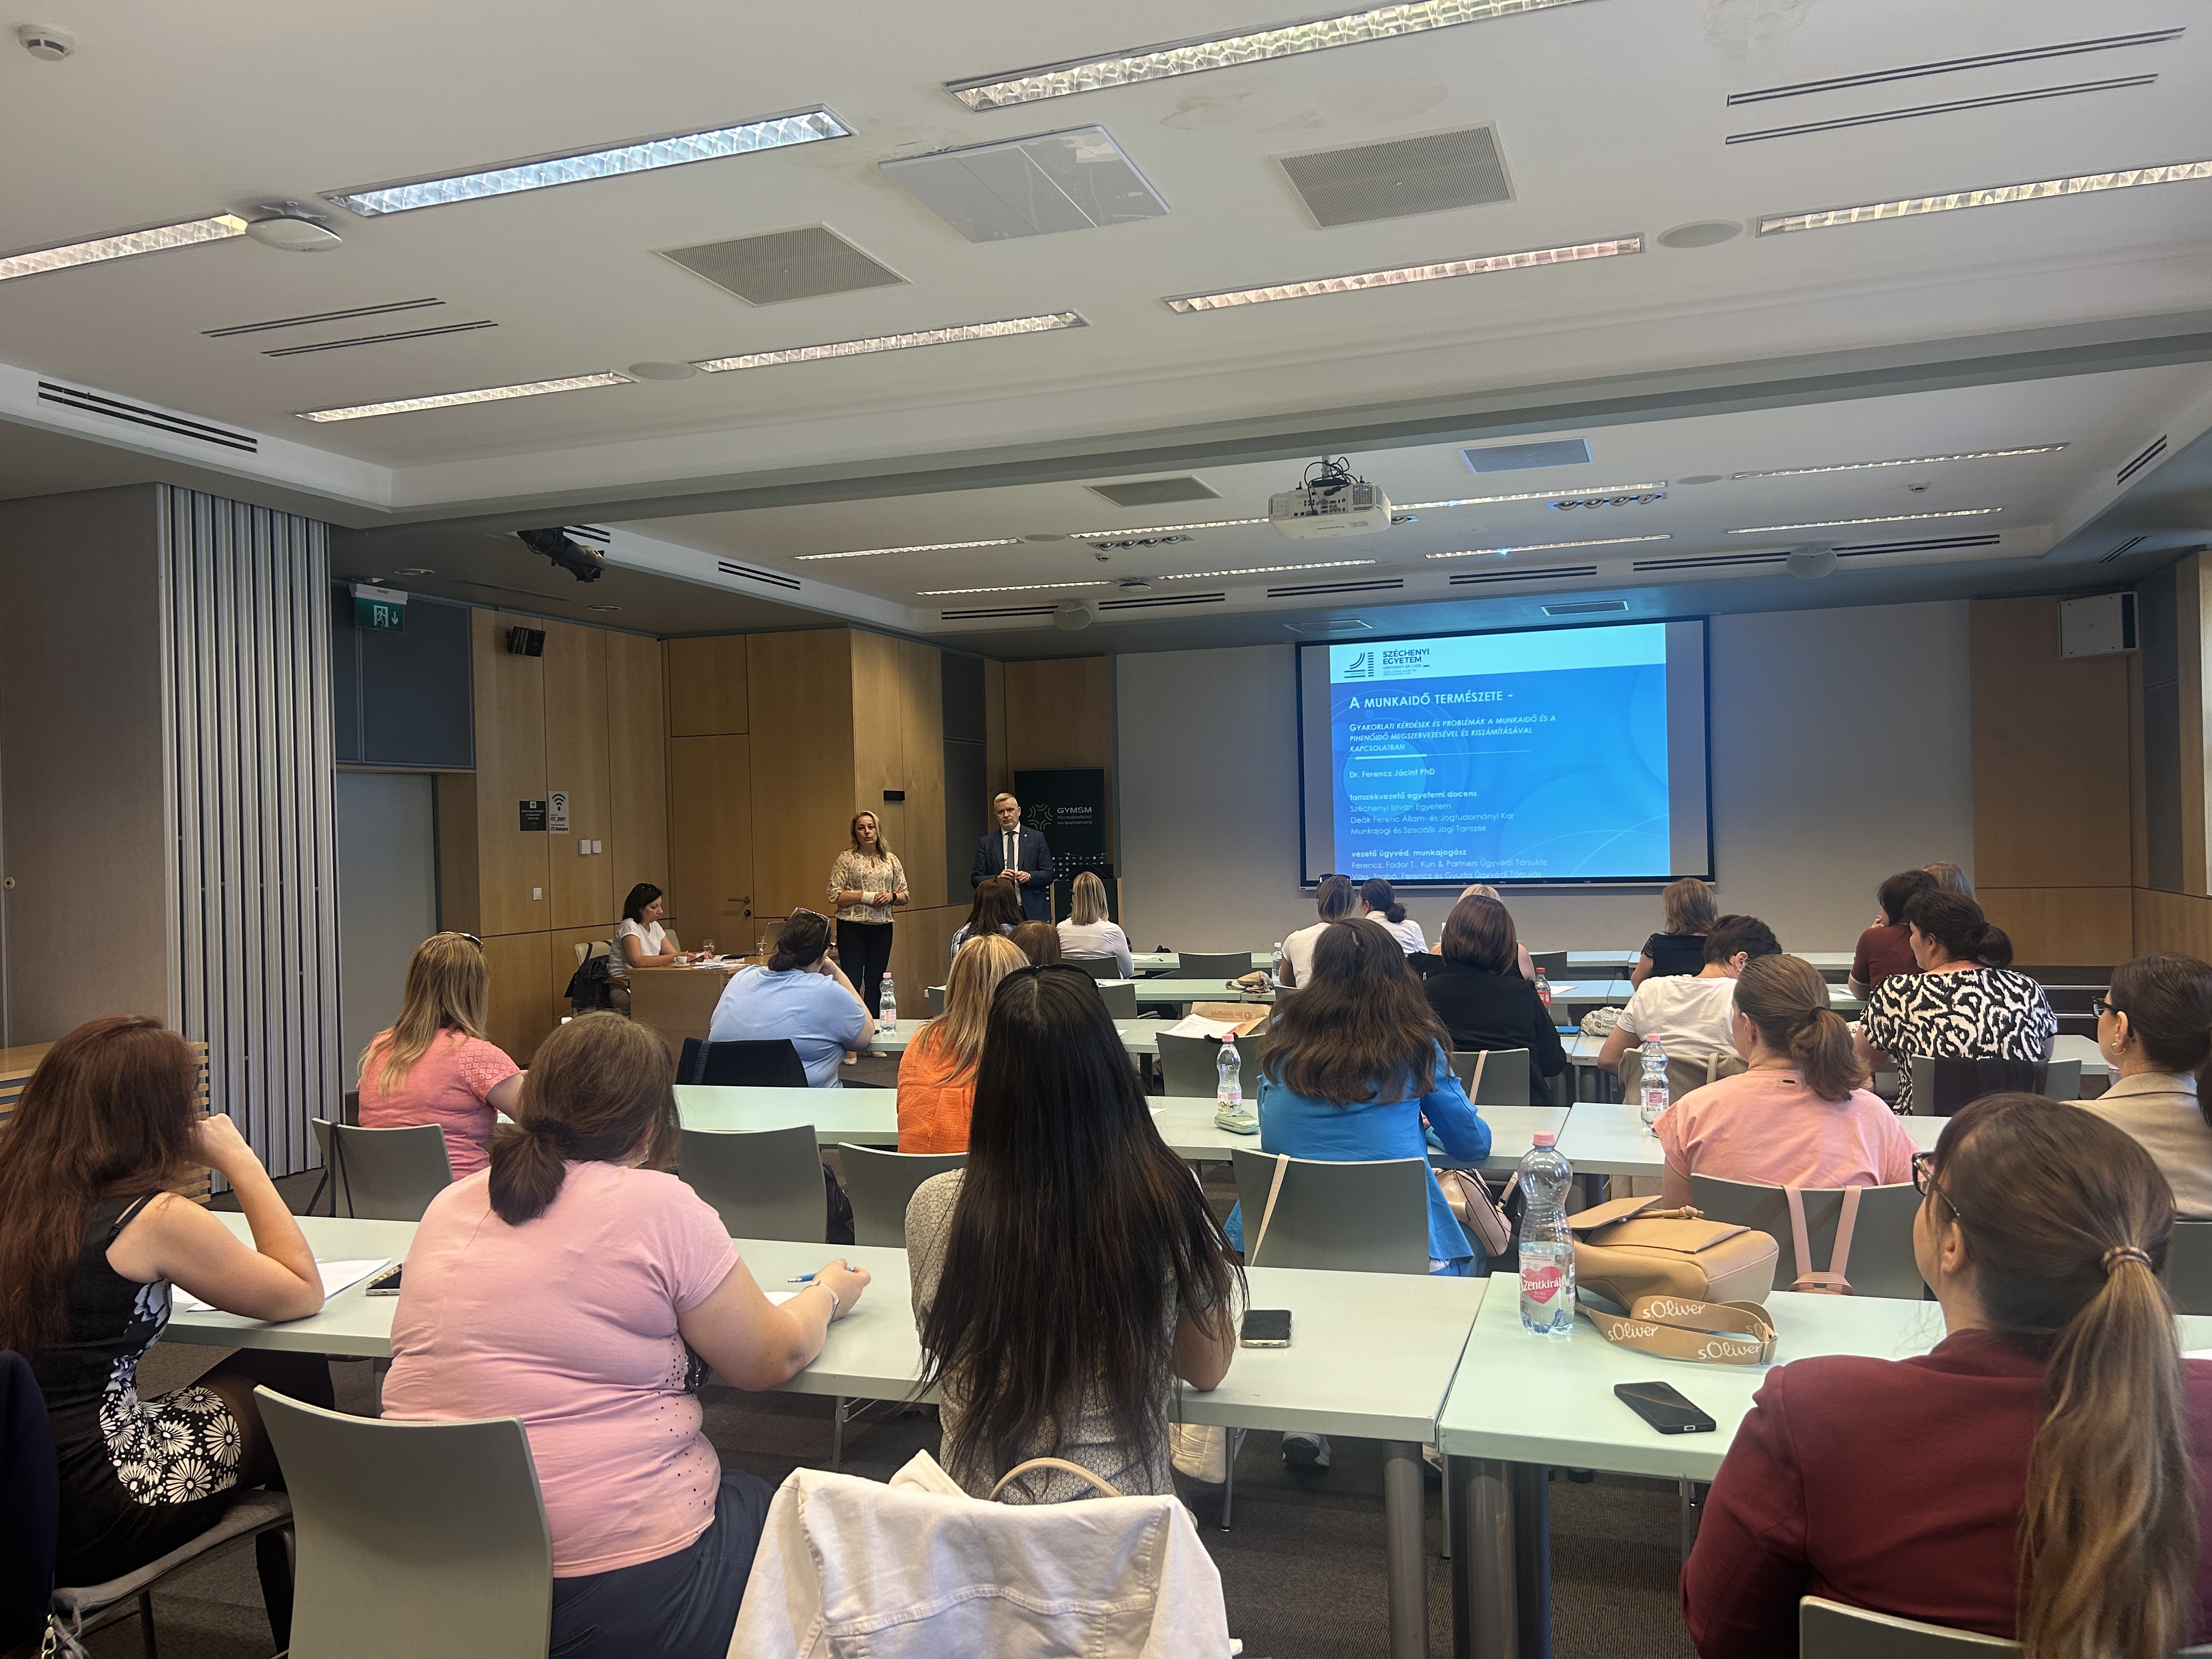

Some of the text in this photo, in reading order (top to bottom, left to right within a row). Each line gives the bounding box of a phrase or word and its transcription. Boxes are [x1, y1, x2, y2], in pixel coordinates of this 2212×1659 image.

[1383, 648, 1429, 658] SZÉCHENYI
[1383, 656, 1422, 665] EGYETEM
[1348, 696, 1360, 709] A
[1364, 693, 1431, 708] MUNKAIDŐ
[1434, 690, 1503, 704] TERMÉSZETE
[1349, 723, 1395, 732] GYAKORLATI
[1396, 720, 1430, 730] KÉRDÉSEK
[1432, 719, 1441, 727] ÉS
[1442, 716, 1486, 727] PROBLÉMÁK
[1495, 714, 1537, 724] MUNKAIDŐ
[1539, 713, 1548, 722] ÉS
[1349, 726, 1532, 742] PIHENŐIDŐ MEGSZERVEZÉSÉVEL ÉS KISZÁMÍTÁSÁVAL
[1349, 743, 1406, 753] KAPCSOLATBAN
[1350, 792, 1406, 801] tanszékvezető
[1407, 791, 1445, 800] egyetemi
[1350, 804, 1389, 812] Széchenyi
[1415, 803, 1451, 812] Egyetem
[1402, 814, 1427, 822] Állam-
[1440, 812, 1499, 822] Jogtudományi
[1350, 827, 1391, 836] Munkajogi
[1437, 825, 1454, 834] Jogi
[1455, 824, 1487, 832] Tanszék
[1351, 848, 1466, 858] vezető ügyvéd, munkajogász
[1351, 861, 1384, 870] Ferencz,
[1437, 860, 1444, 868] &
[1480, 857, 1514, 868] Ügyvédi
[1515, 858, 1547, 866] Társulás
[1510, 870, 1542, 878] Társulás
[1642, 1300, 1706, 1319] s.Oliver
[1607, 1322, 1658, 1341] s.Oliver
[1698, 1341, 1763, 1359] s.Oliver
